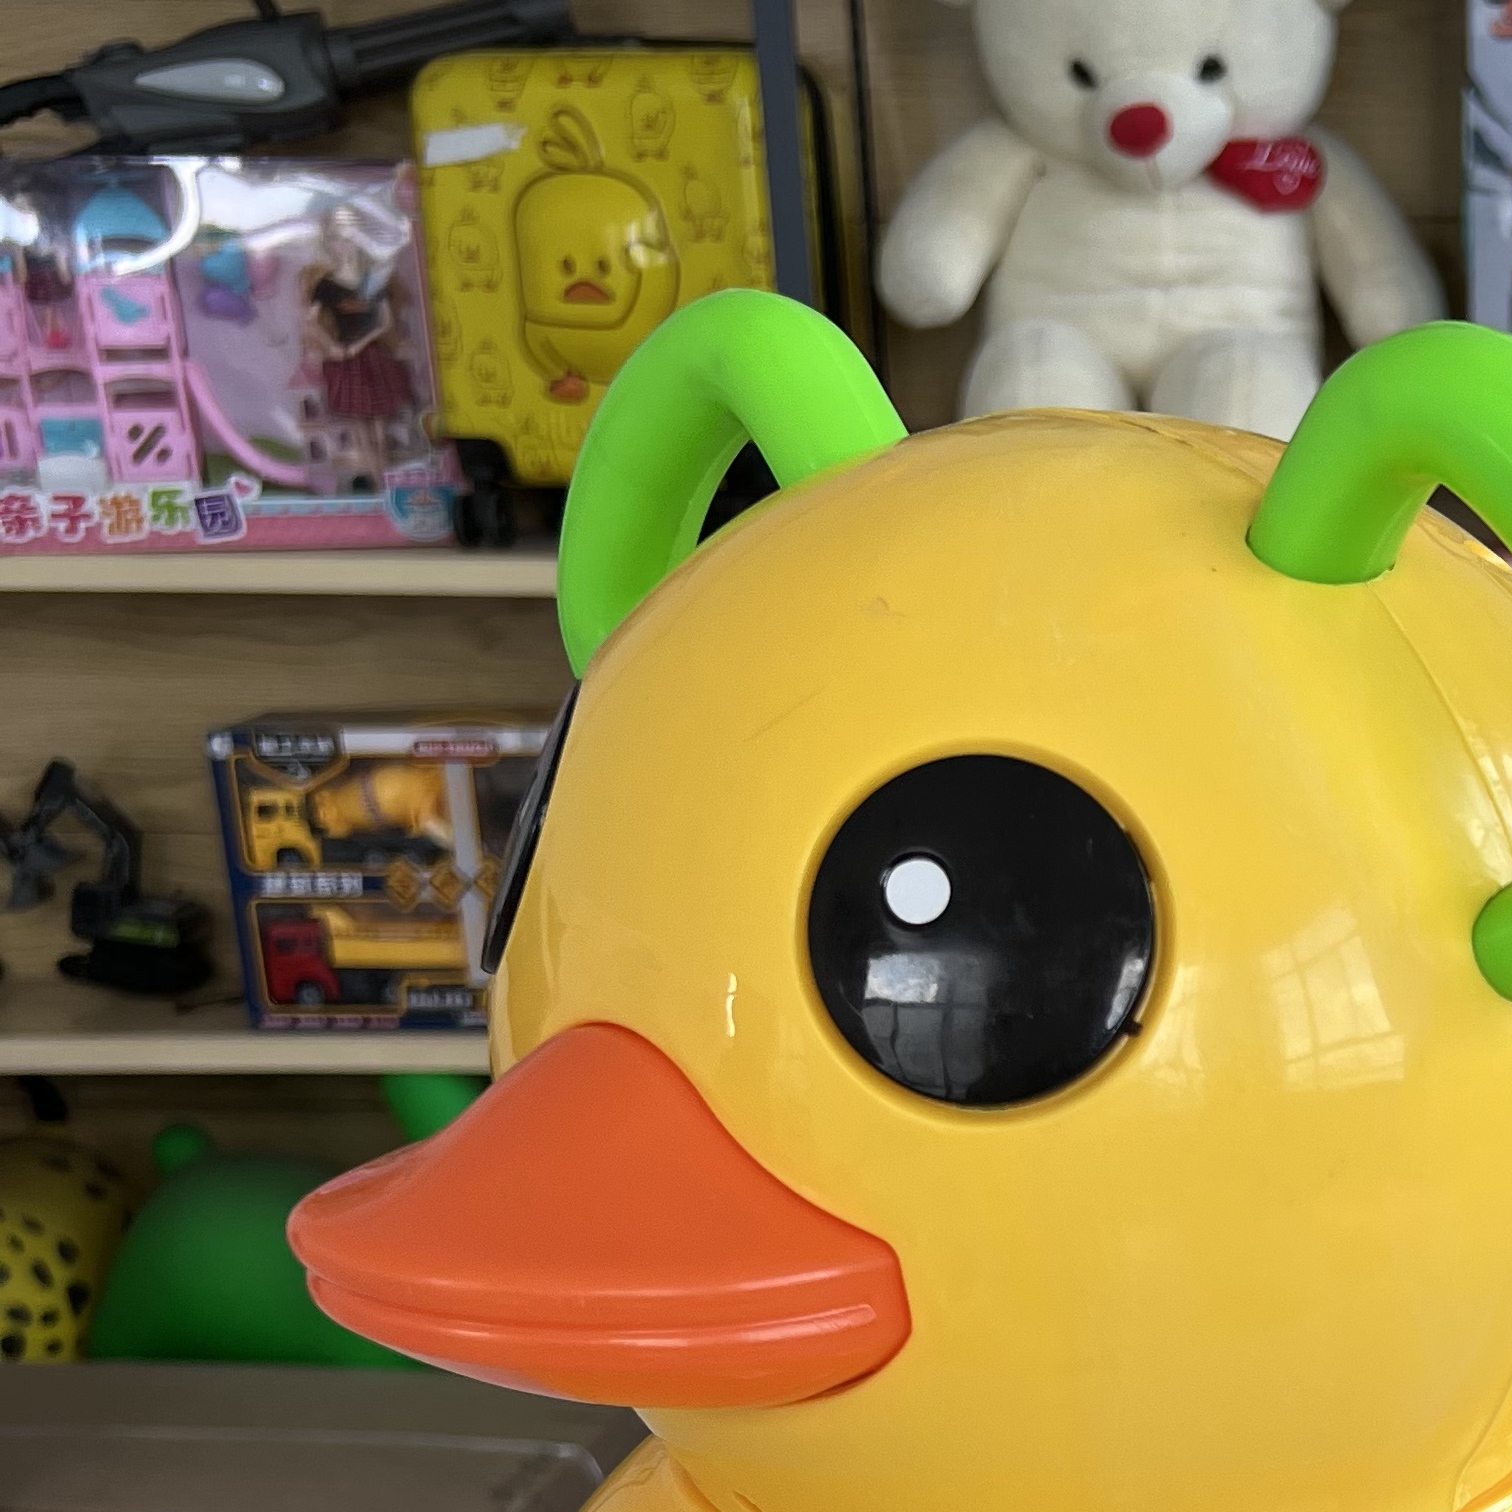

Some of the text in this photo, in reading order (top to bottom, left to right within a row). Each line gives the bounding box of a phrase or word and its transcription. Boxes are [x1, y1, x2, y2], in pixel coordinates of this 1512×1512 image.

[0, 487, 244, 539] 亲子游乐园
